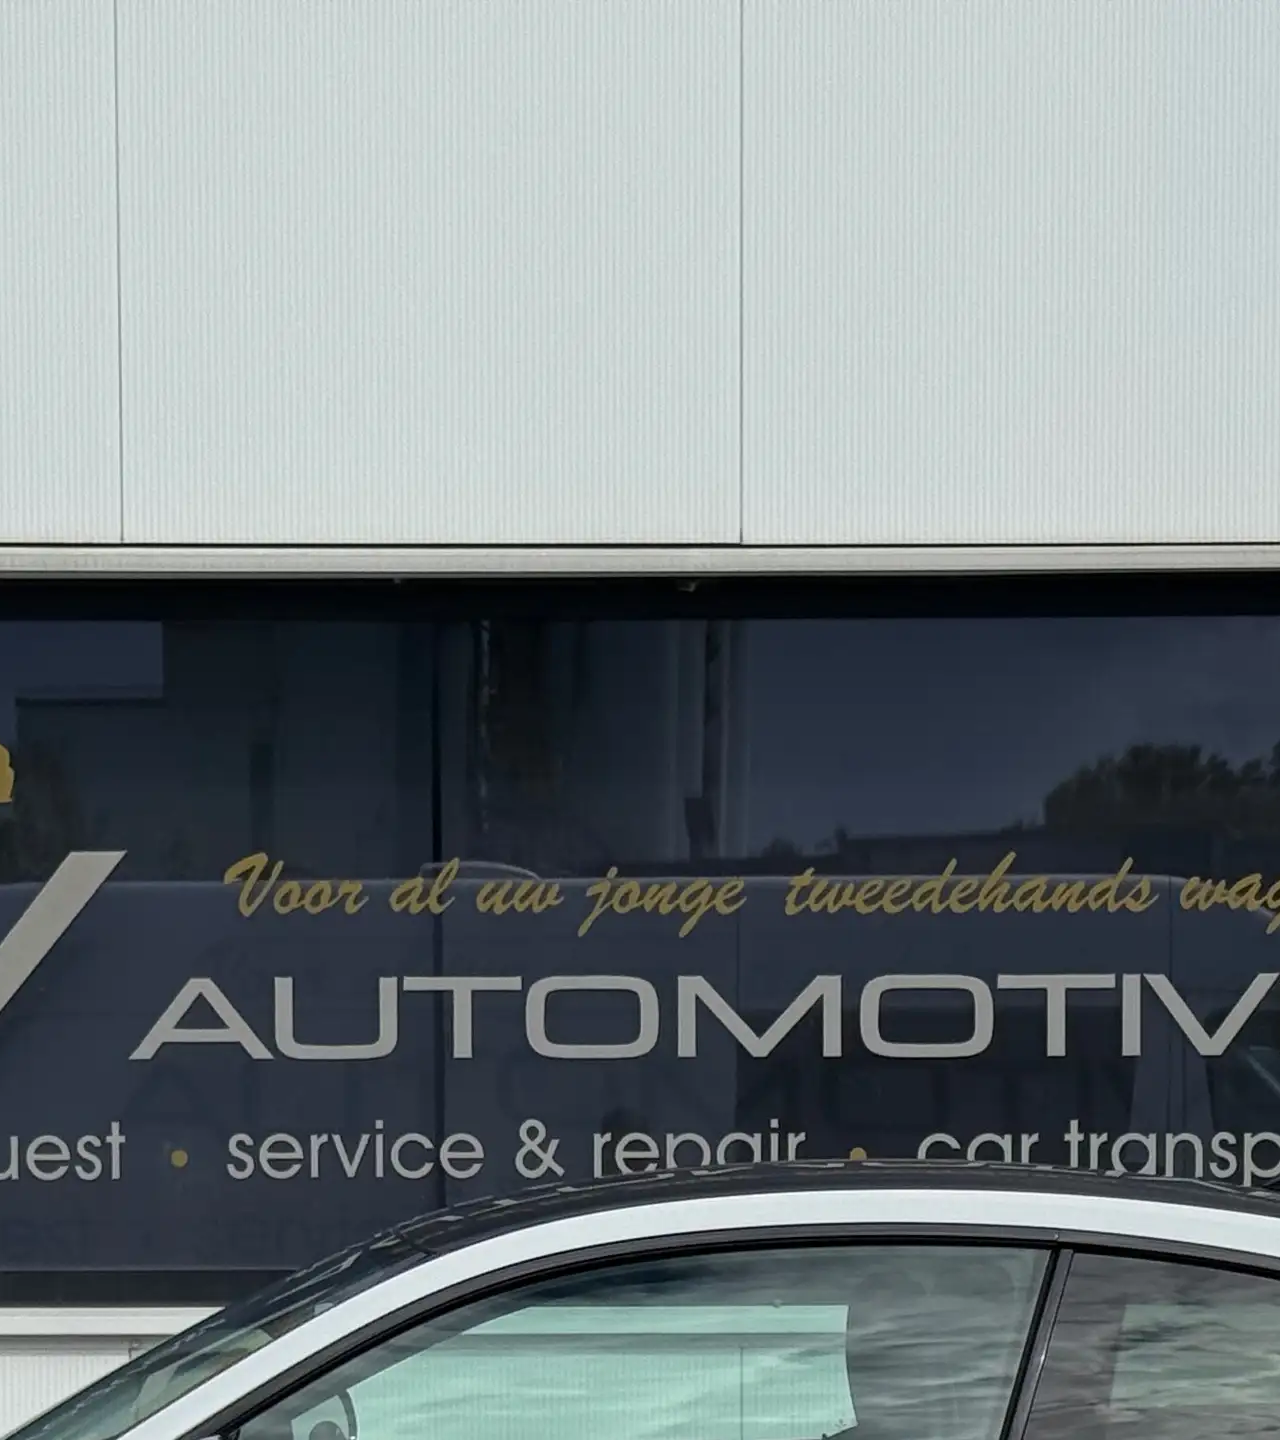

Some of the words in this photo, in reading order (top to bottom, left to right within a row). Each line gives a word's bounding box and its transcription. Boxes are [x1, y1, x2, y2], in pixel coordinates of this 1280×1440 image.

[224, 852, 365, 917] Voor
[388, 858, 460, 914] al
[476, 880, 563, 915] uw
[577, 867, 747, 937] jonge
[785, 852, 1160, 915] tweedehands
[227, 1119, 484, 1180] service
[515, 1118, 565, 1179] &
